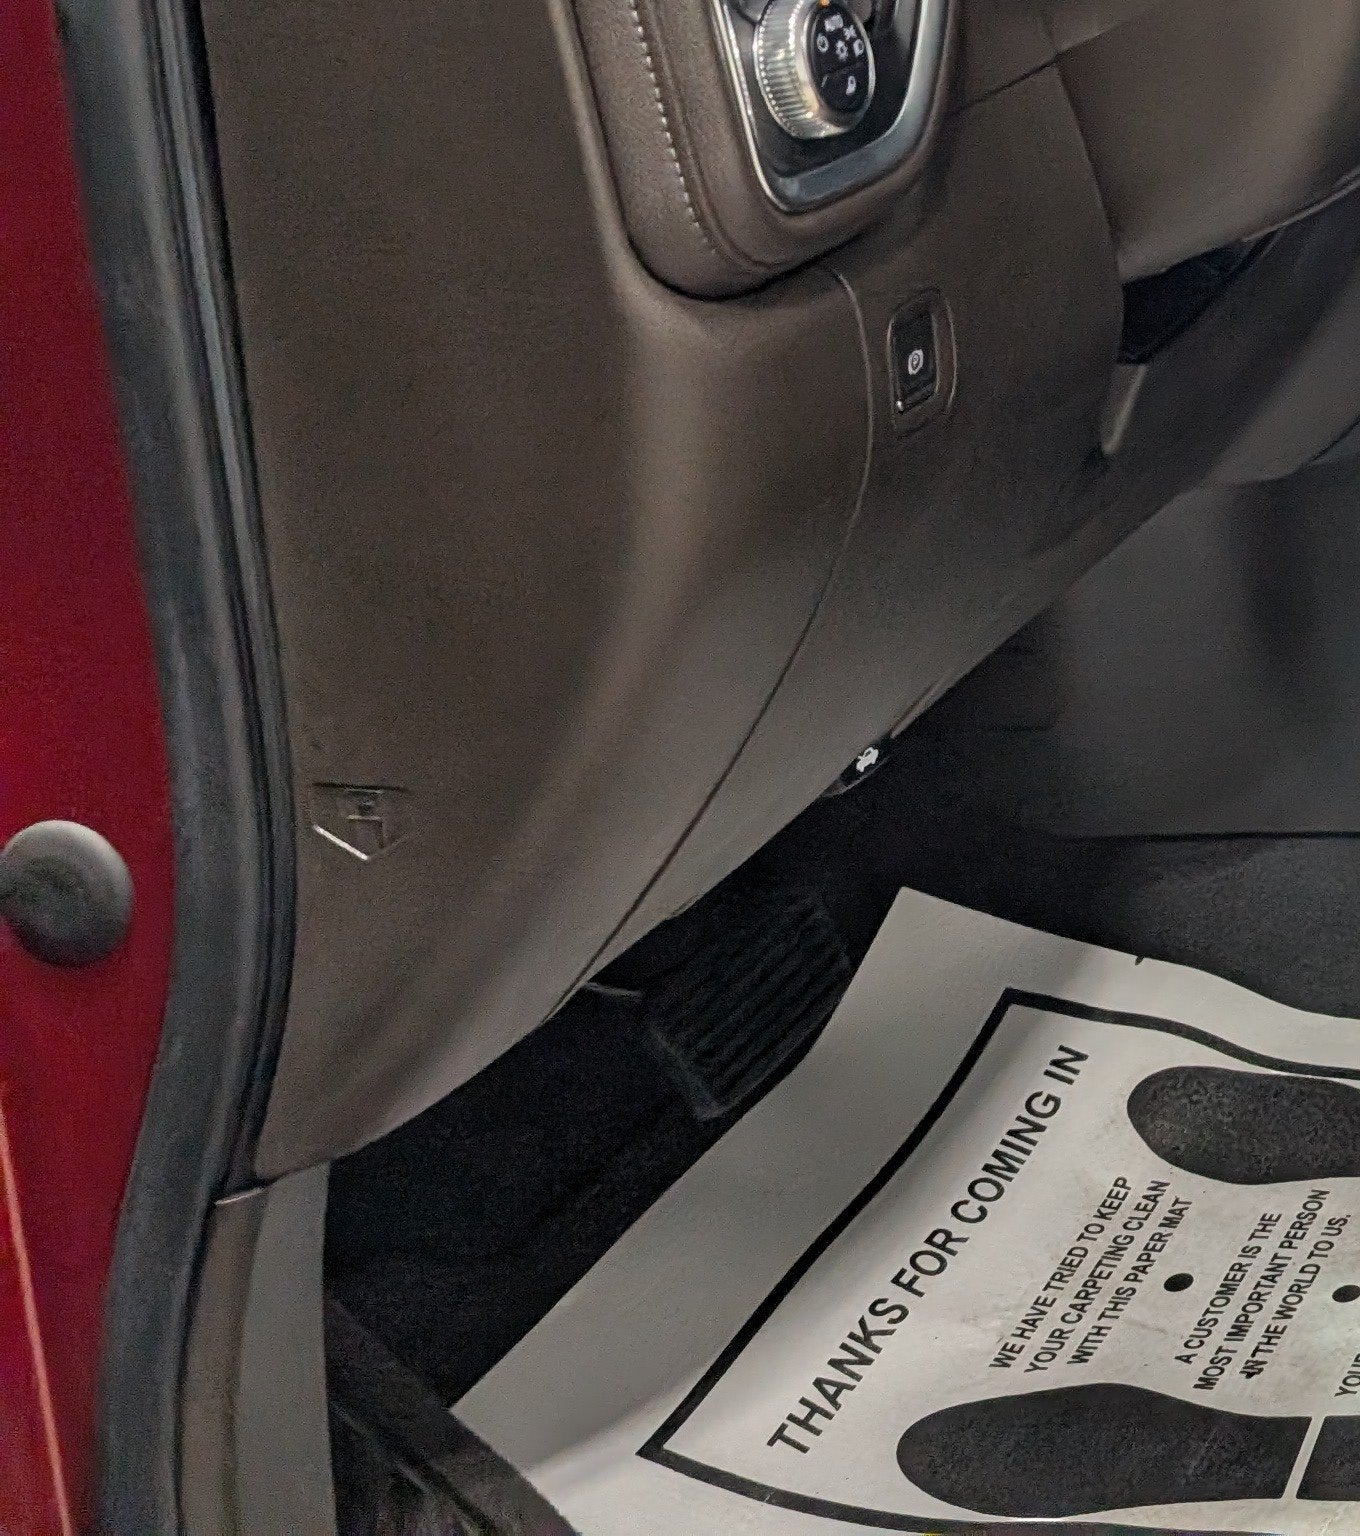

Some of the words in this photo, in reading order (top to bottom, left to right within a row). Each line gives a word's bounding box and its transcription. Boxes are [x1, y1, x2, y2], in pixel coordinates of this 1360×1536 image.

[766, 1297, 910, 1454] THANKS
[890, 1227, 970, 1298] FOR
[951, 1090, 1062, 1225] COMING
[1043, 1044, 1089, 1086] IN
[989, 1342, 1026, 1369] WE
[1011, 1295, 1057, 1340] HAVE
[1042, 1246, 1089, 1291] TRIED
[1076, 1222, 1105, 1242] TO
[1097, 1176, 1132, 1221] KEEP
[1024, 1328, 1075, 1373] YOUR
[1060, 1234, 1135, 1325] CARPETING
[1122, 1180, 1171, 1231] CLEAN
[1066, 1325, 1113, 1365] WITH
[1097, 1286, 1137, 1322] THIS
[1123, 1232, 1174, 1283] PAPER
[1158, 1196, 1193, 1230] MAT
[1192, 1346, 1238, 1390] MOST
[1224, 1252, 1292, 1342] IMPORTANT
[1278, 1189, 1331, 1250] PERSON
[1238, 1245, 1262, 1259] IS
[1248, 1213, 1283, 1241] THE
[1174, 1353, 1199, 1365] A
[1183, 1262, 1253, 1349] CUSTOMER
[1250, 1324, 1288, 1358] THE
[1271, 1263, 1321, 1321] WORLD
[1307, 1240, 1335, 1260] TO
